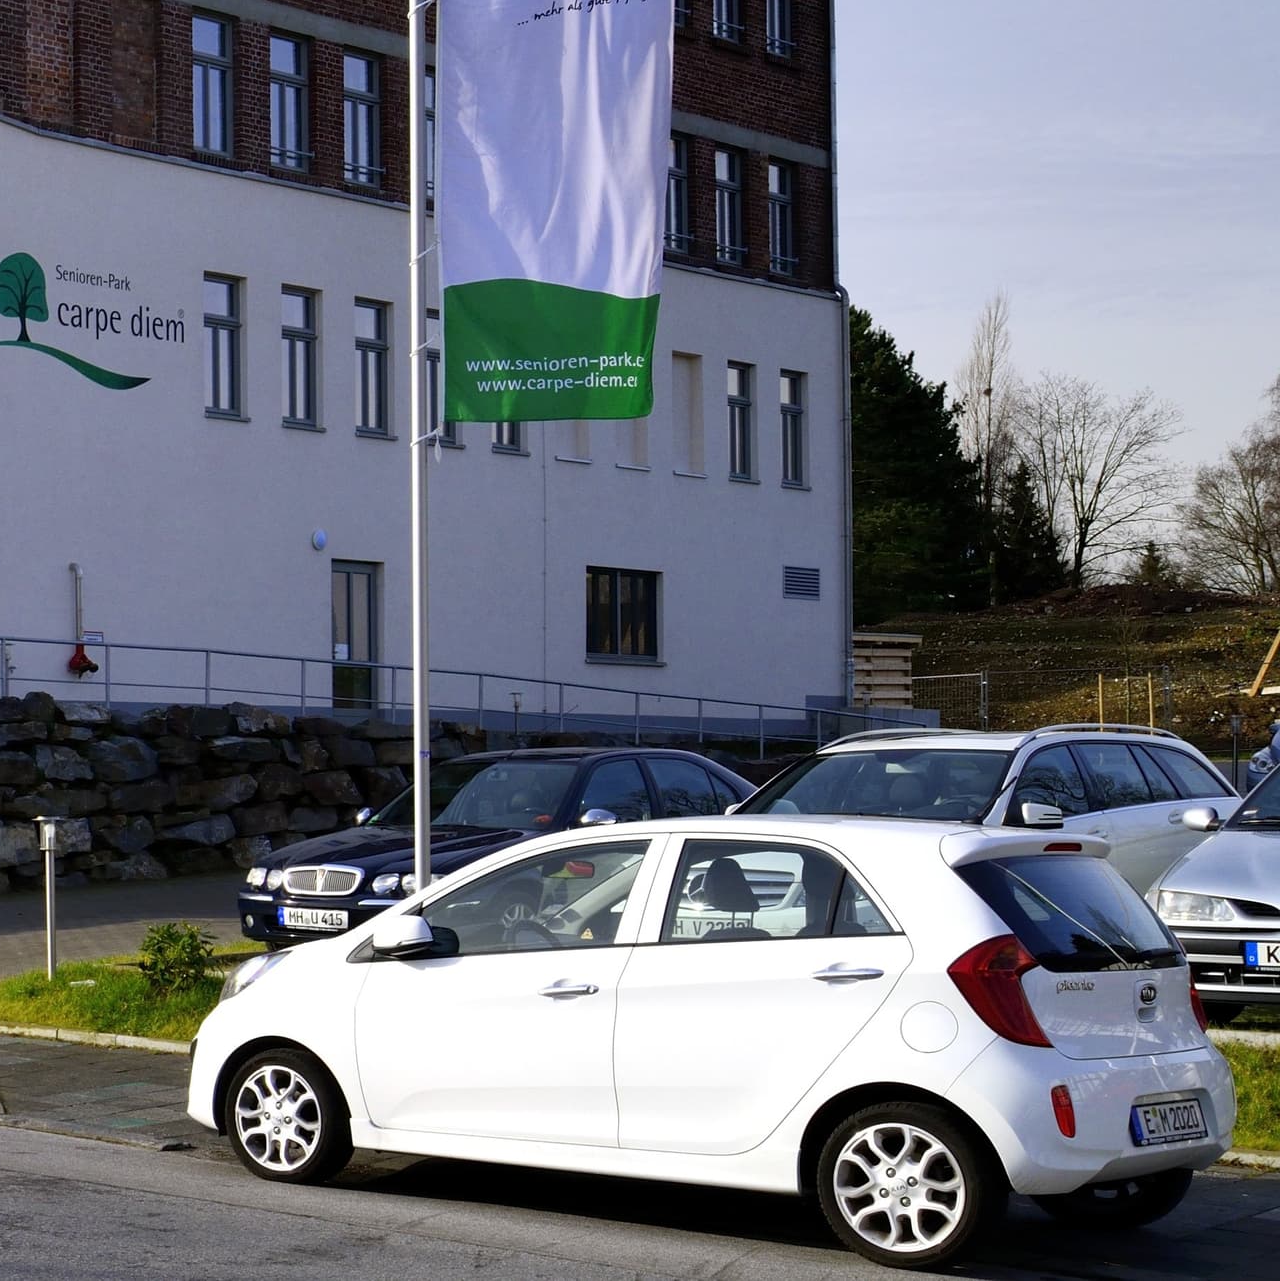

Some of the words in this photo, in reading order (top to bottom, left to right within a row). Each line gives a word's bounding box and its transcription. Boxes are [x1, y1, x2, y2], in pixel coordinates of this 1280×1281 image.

[534, 1, 563, 21] mehr
[55, 265, 131, 292] Senioren-Park
[57, 302, 121, 340] carpe
[1056, 980, 1095, 994] picanto
[1169, 1104, 1200, 1131] 2020
